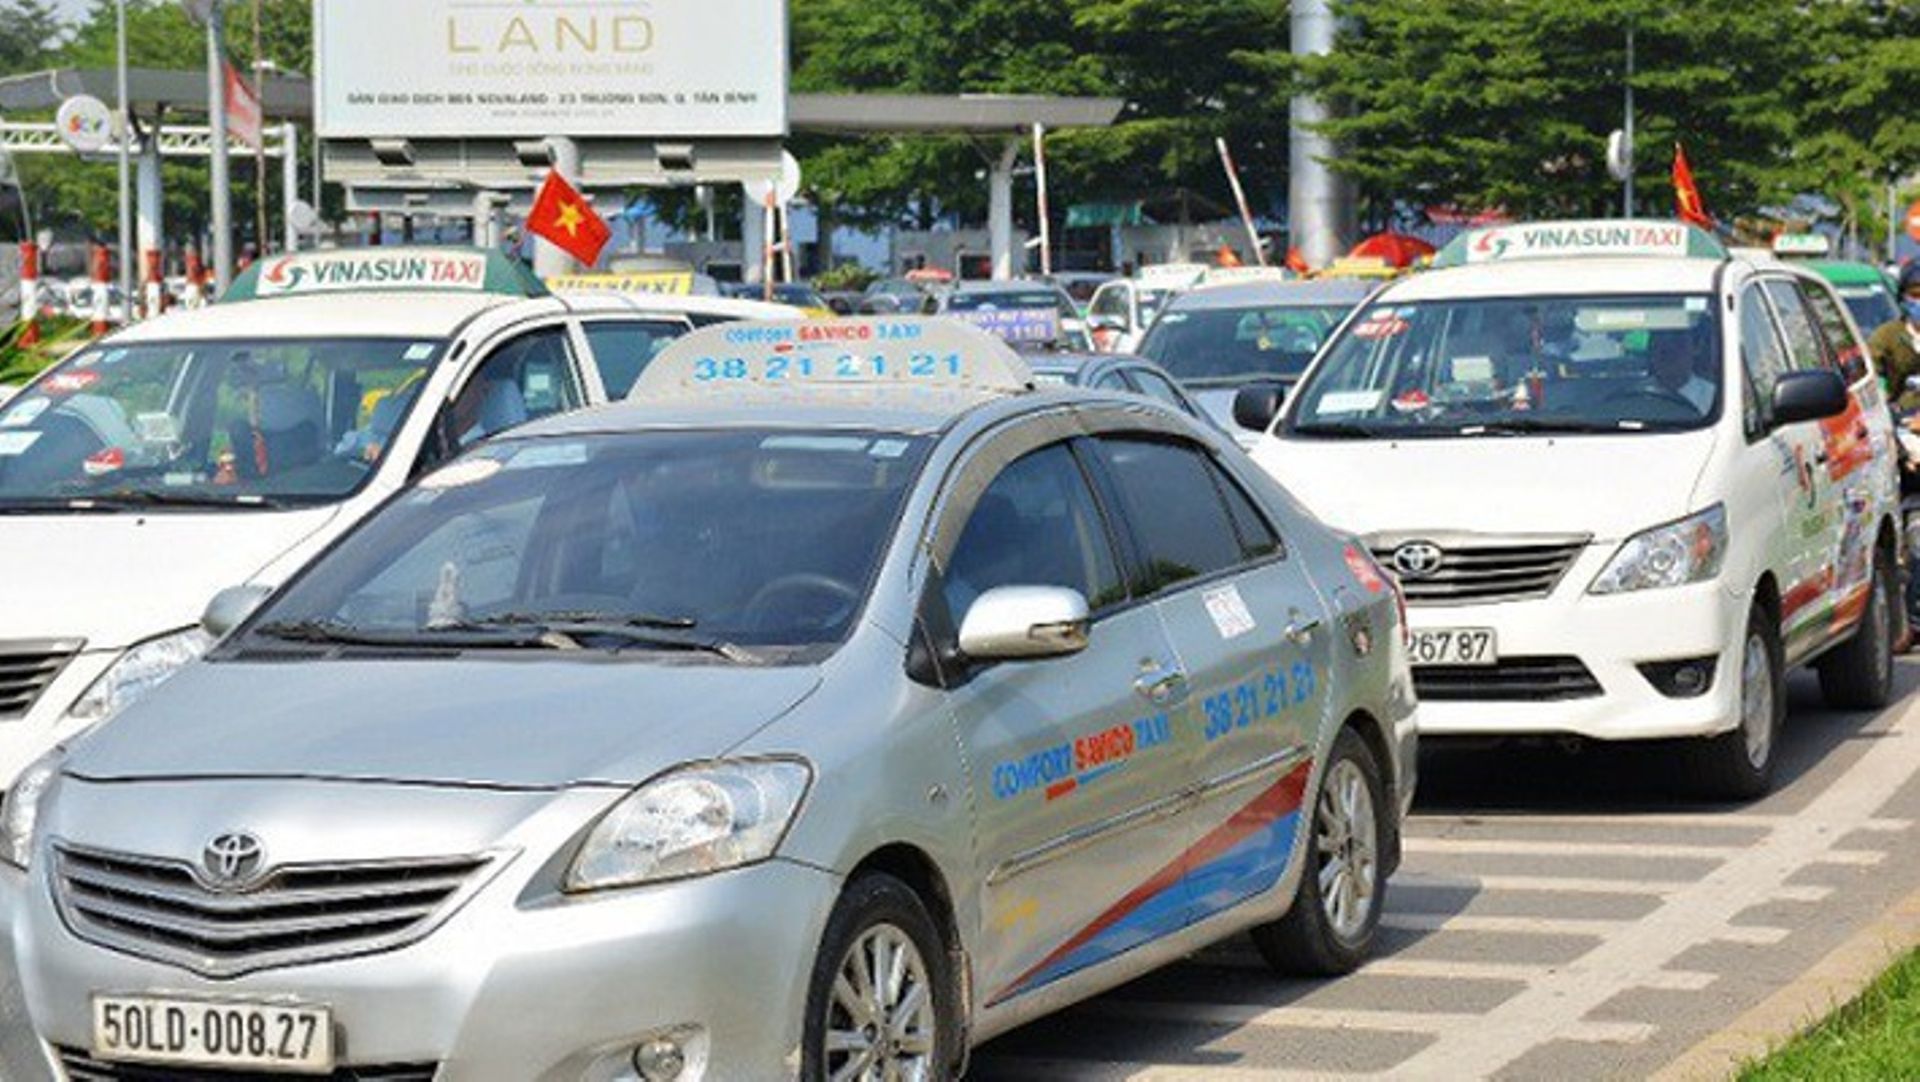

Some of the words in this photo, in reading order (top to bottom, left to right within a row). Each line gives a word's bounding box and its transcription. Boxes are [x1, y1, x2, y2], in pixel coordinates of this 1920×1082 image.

[447, 16, 654, 52] LAND
[1523, 227, 1631, 248] VINASUN
[1634, 226, 1682, 247] TAXI
[313, 257, 426, 284] VINASUN
[430, 259, 482, 284] TAXI
[694, 357, 747, 379] 38
[763, 355, 814, 379] 21
[836, 354, 885, 376] 21
[908, 353, 961, 376] 21
[1203, 691, 1233, 740] 38
[1236, 683, 1259, 728] 21
[1264, 669, 1287, 716] 21
[1291, 659, 1315, 703] 21
